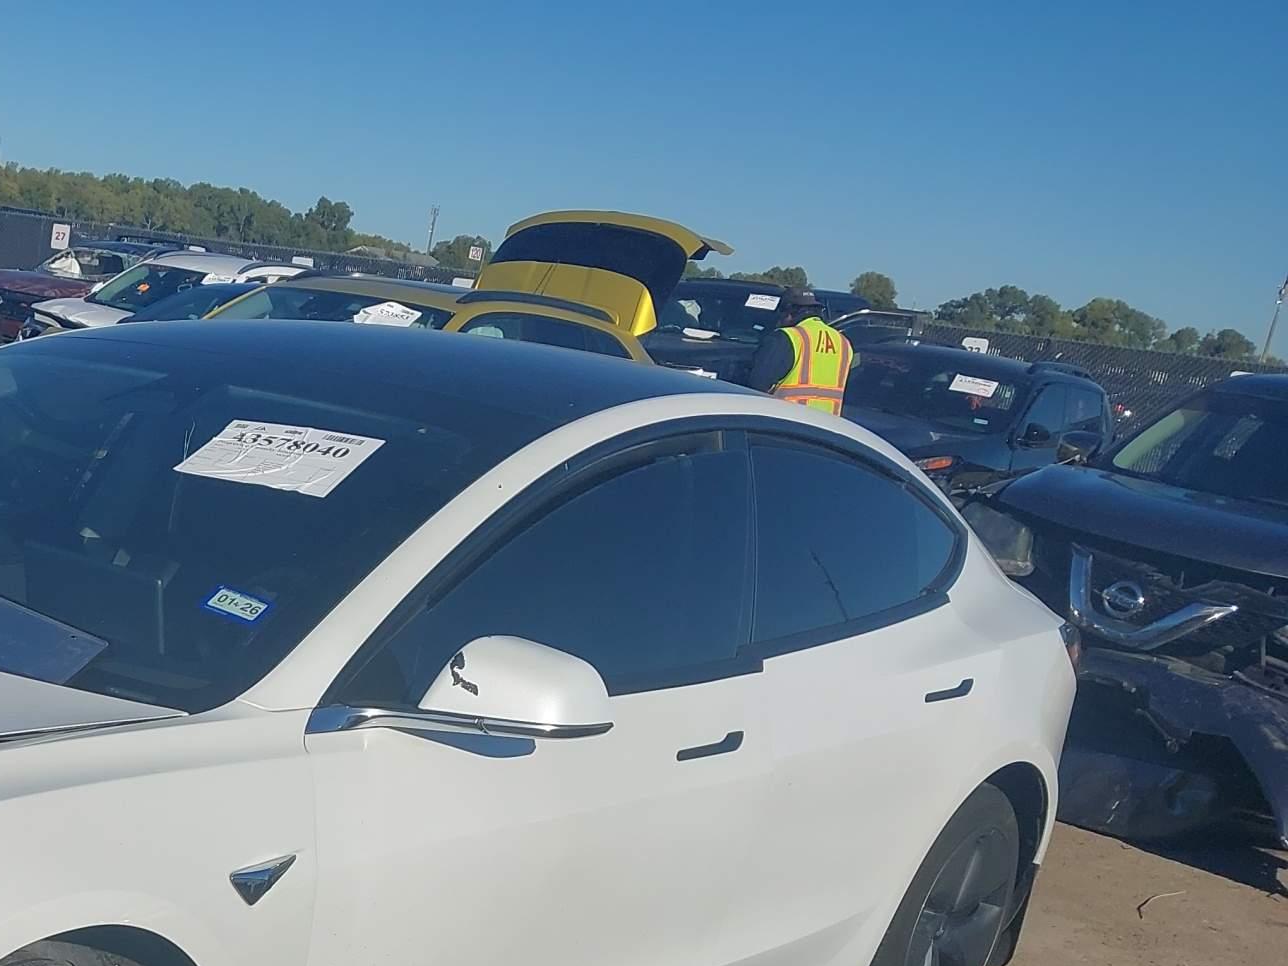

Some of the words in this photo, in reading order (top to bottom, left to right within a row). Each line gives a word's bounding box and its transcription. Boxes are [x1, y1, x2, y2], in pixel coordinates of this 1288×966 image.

[55, 231, 66, 241] 27
[232, 431, 351, 459] 43578040
[217, 594, 237, 606] 01
[240, 602, 261, 615] 26
